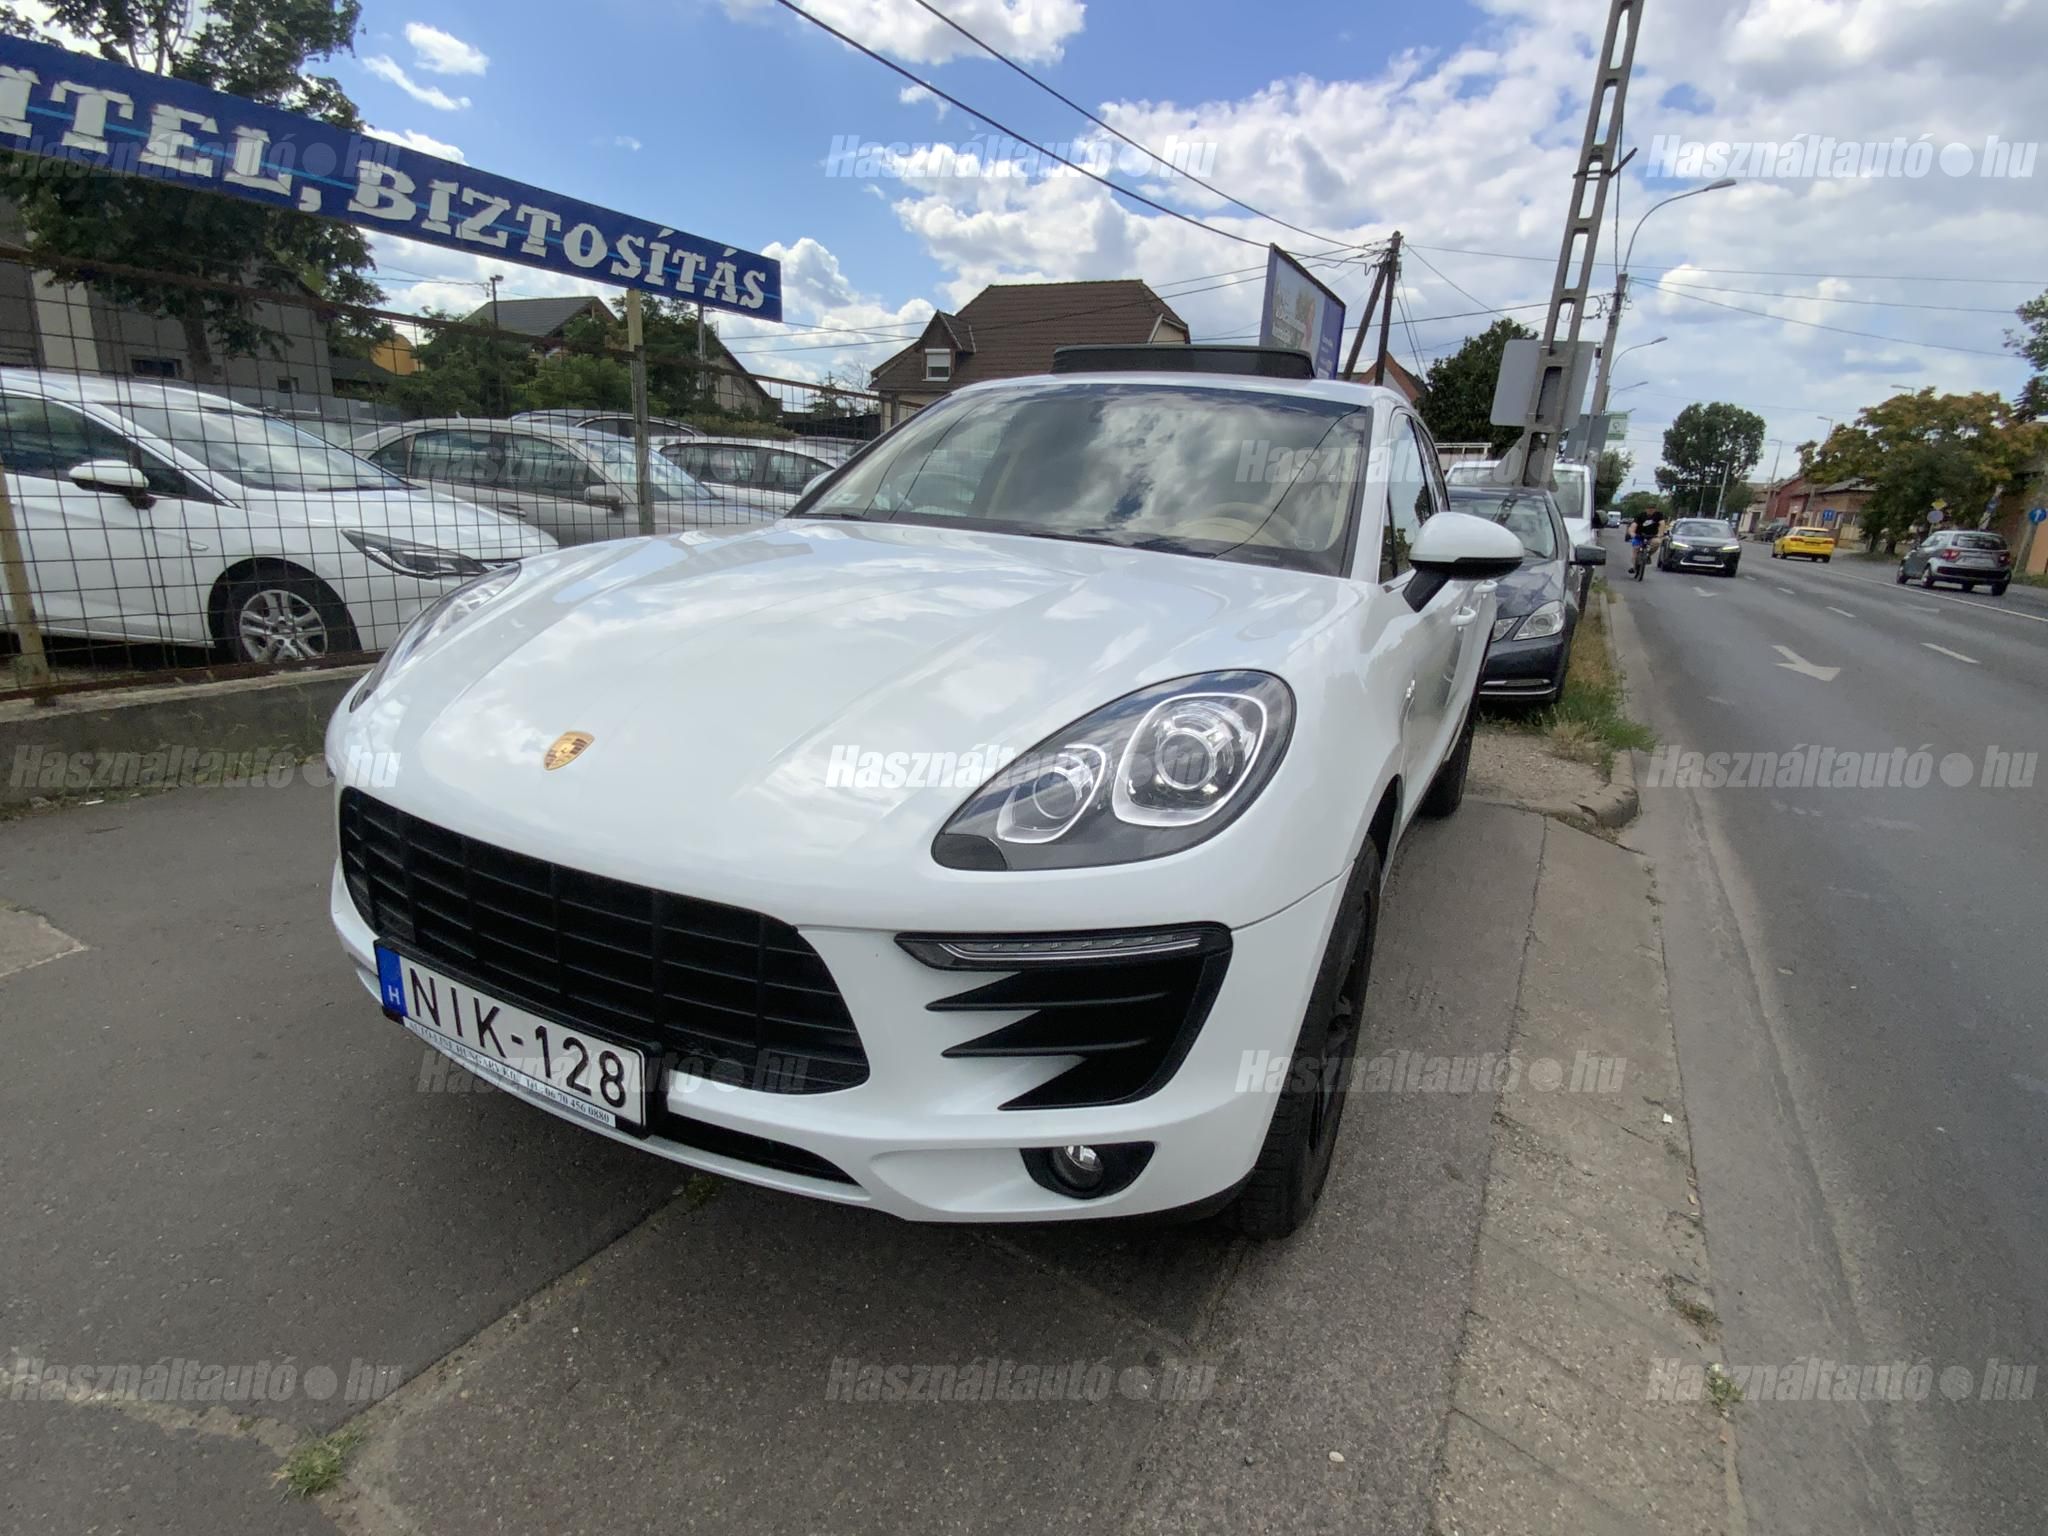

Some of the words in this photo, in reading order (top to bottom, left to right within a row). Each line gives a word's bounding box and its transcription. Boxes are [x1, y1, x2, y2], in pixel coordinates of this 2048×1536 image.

[347, 158, 768, 310] BIZTOSÍTÁS
[388, 984, 401, 1006] H
[409, 967, 627, 1109] NIK-128
